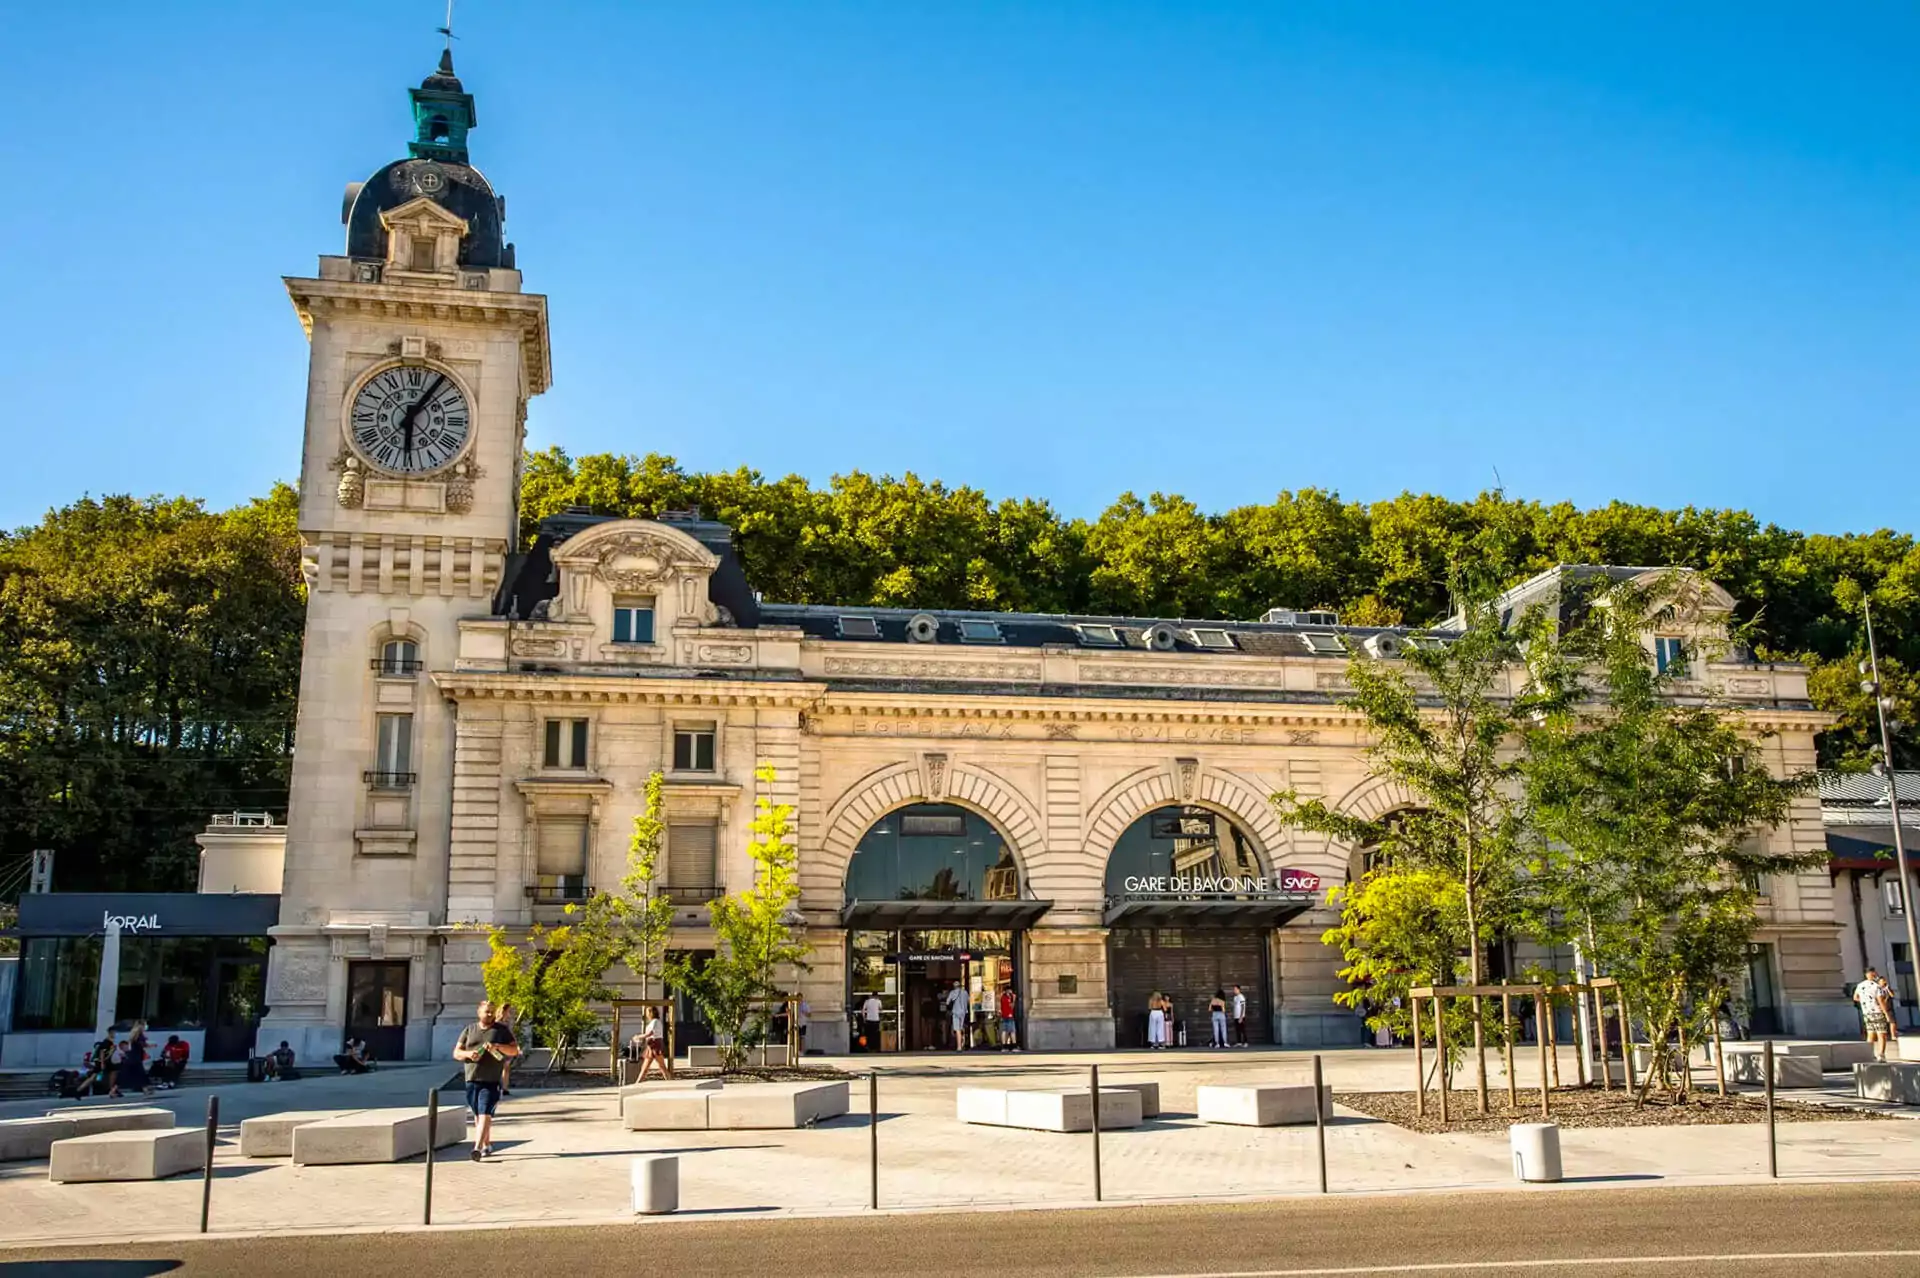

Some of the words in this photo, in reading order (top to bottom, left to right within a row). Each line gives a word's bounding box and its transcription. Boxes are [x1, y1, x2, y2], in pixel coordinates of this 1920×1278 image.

[384, 374, 399, 391] XI
[407, 371, 421, 387] XII
[365, 391, 382, 403] X
[447, 417, 464, 427] III
[1124, 876, 1166, 892] GARE
[1170, 876, 1190, 892] DE
[1193, 876, 1268, 893] BAYONNE
[1283, 876, 1320, 890] SNCF
